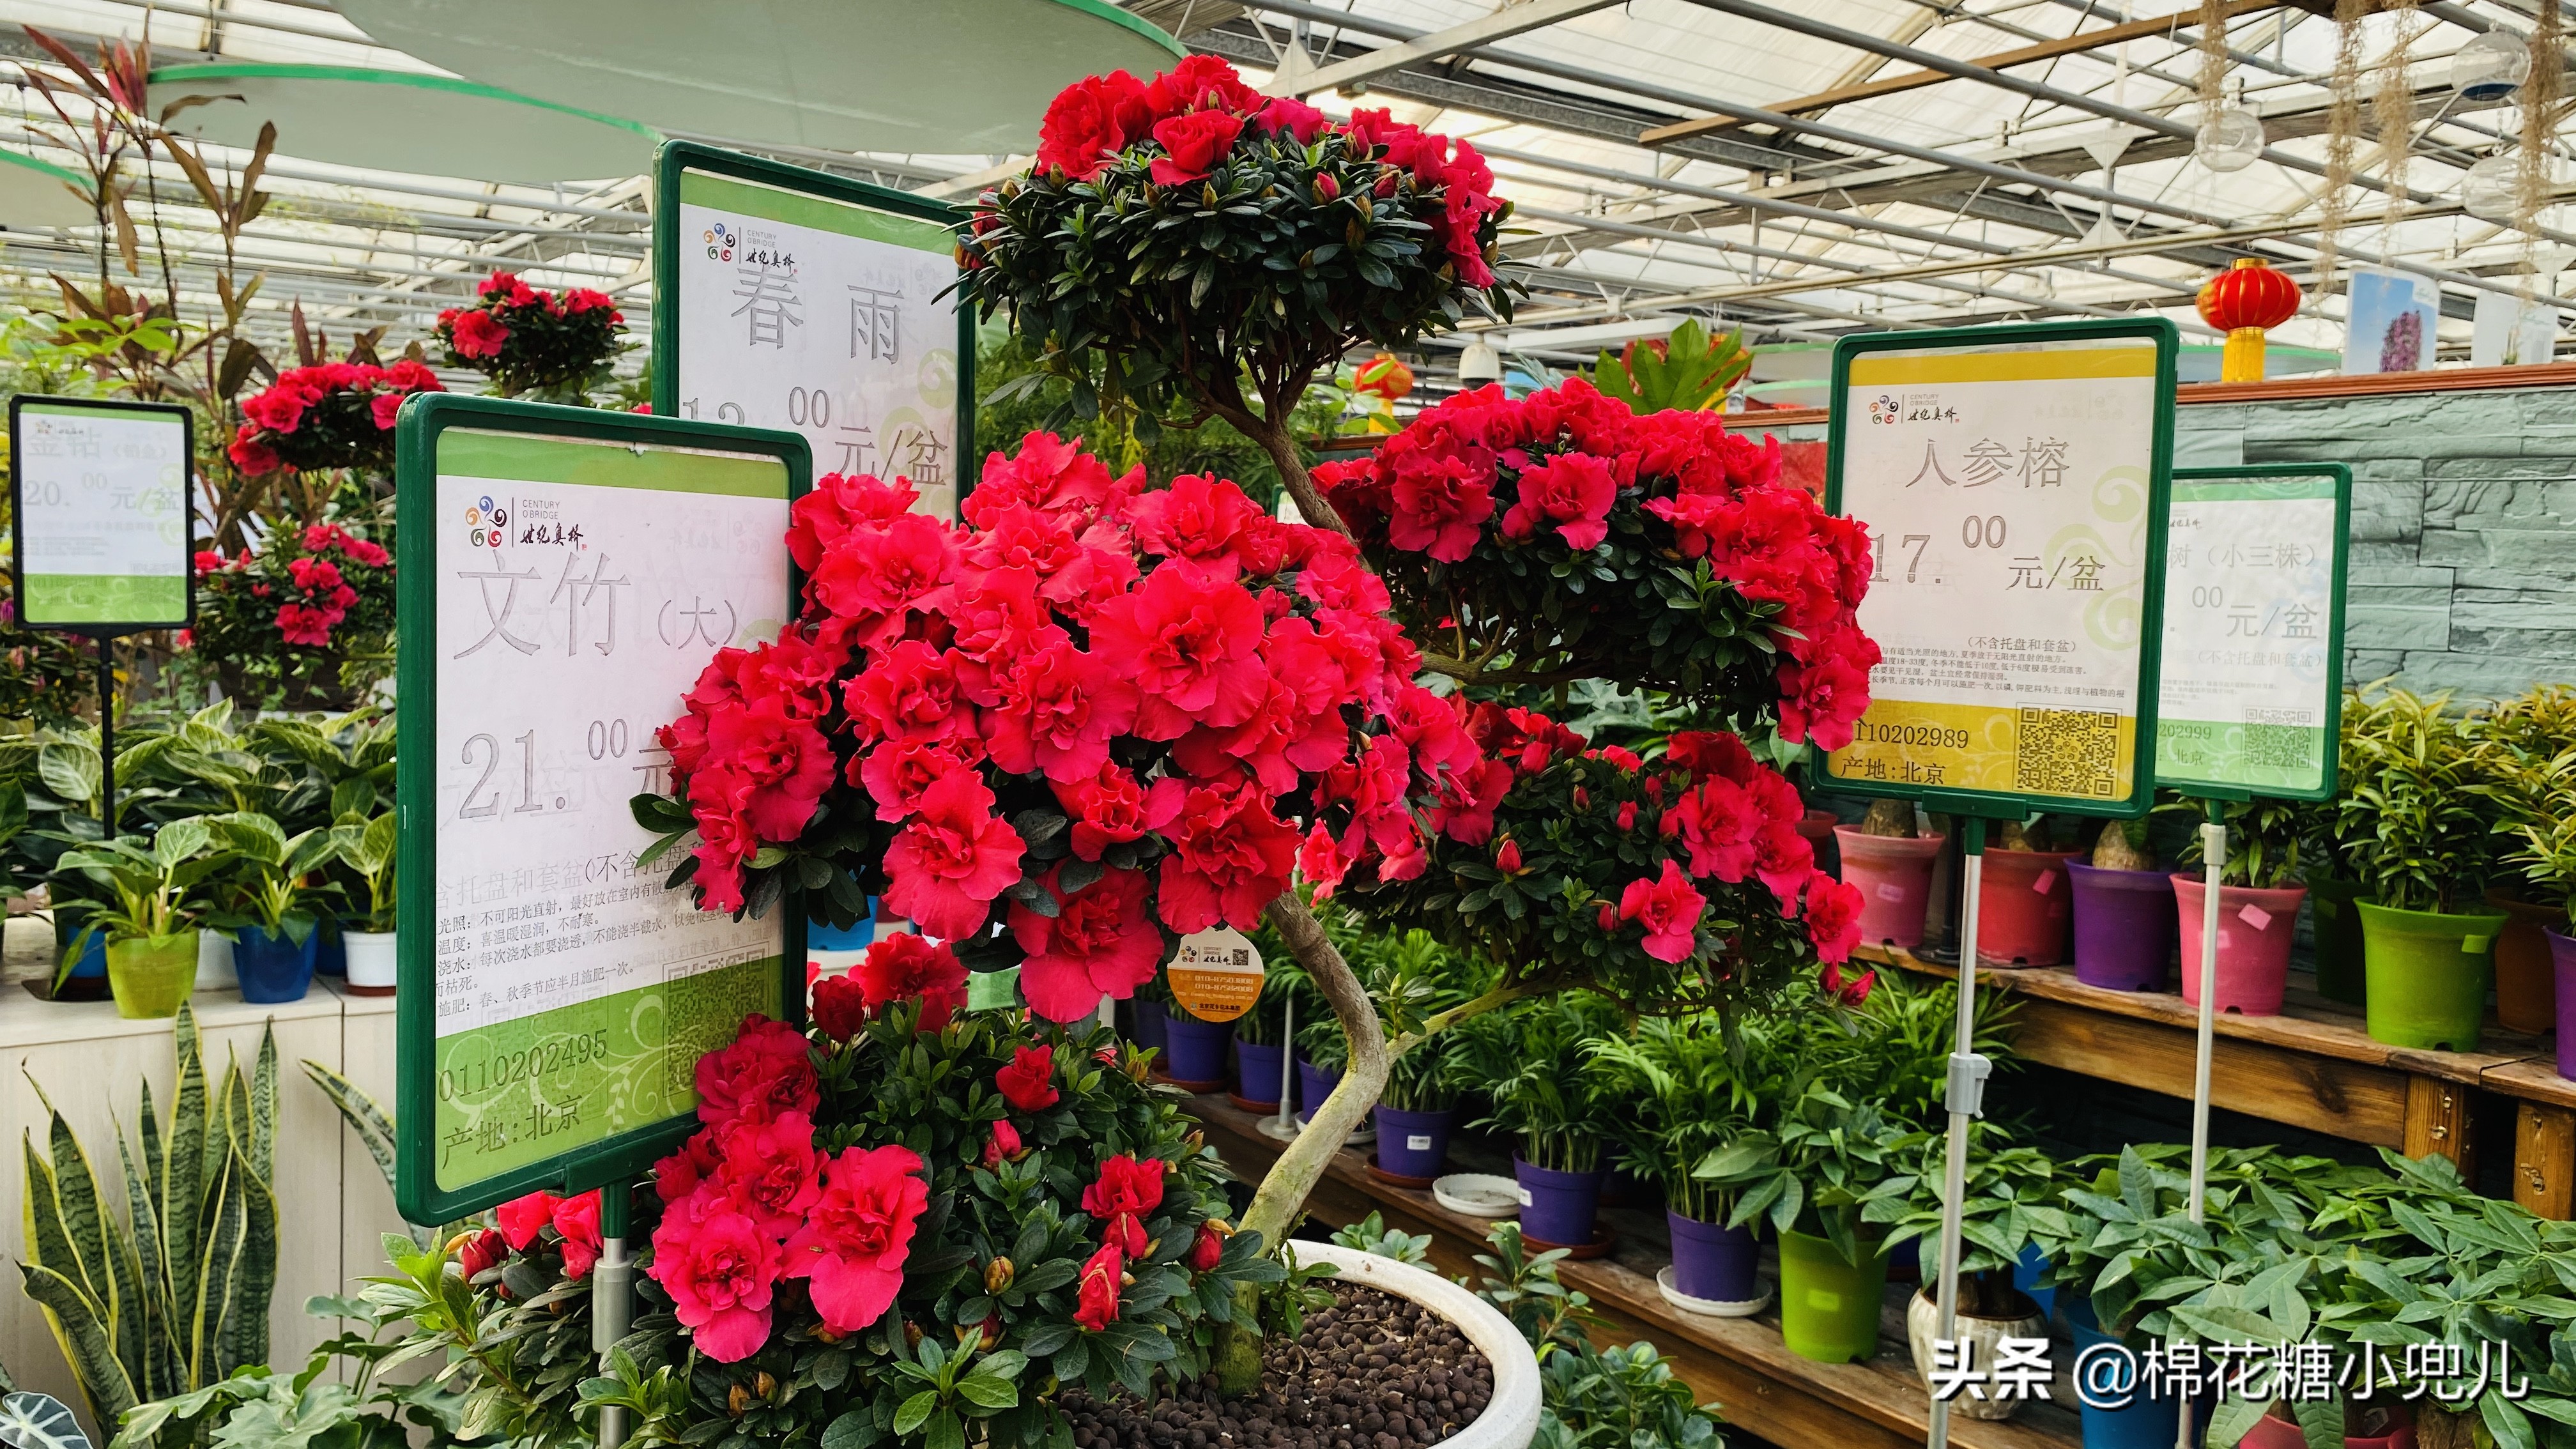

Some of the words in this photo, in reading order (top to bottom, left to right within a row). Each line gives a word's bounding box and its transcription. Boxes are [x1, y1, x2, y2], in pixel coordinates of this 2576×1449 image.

[747, 230, 776, 240] CENTURY
[789, 387, 830, 428] 00
[835, 425, 948, 486] 元/盆
[1906, 437, 2070, 489] 人参榕
[523, 499, 560, 509] CENTURY
[1963, 515, 2006, 549] 00
[2006, 555, 2106, 592] 元/盆
[2192, 586, 2223, 608] 00
[2226, 603, 2318, 639] 元/盆
[588, 719, 628, 760] 00
[1855, 723, 1968, 749] 110202989
[439, 1029, 607, 1102] 0110202495
